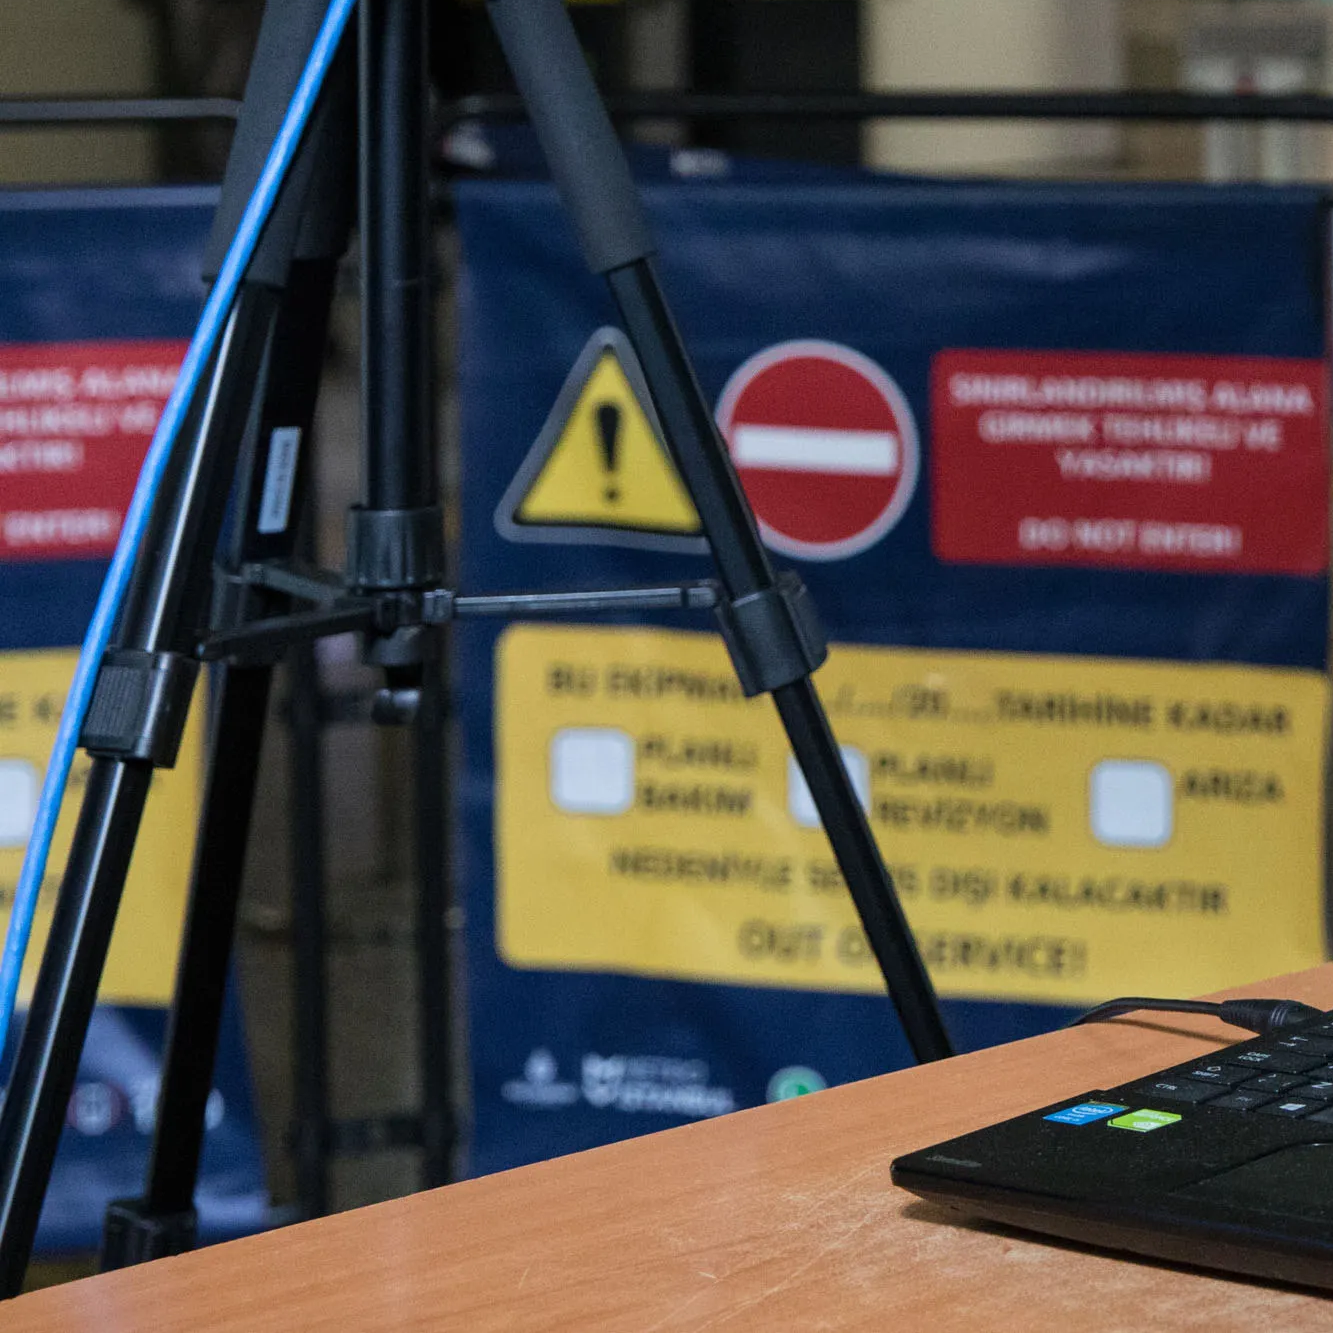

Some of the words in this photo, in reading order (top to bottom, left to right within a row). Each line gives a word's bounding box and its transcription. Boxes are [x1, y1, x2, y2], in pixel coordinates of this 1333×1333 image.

[1162, 697, 1292, 735] KADAR
[736, 918, 825, 965] OUT
[1311, 1081, 1333, 1090] Z
